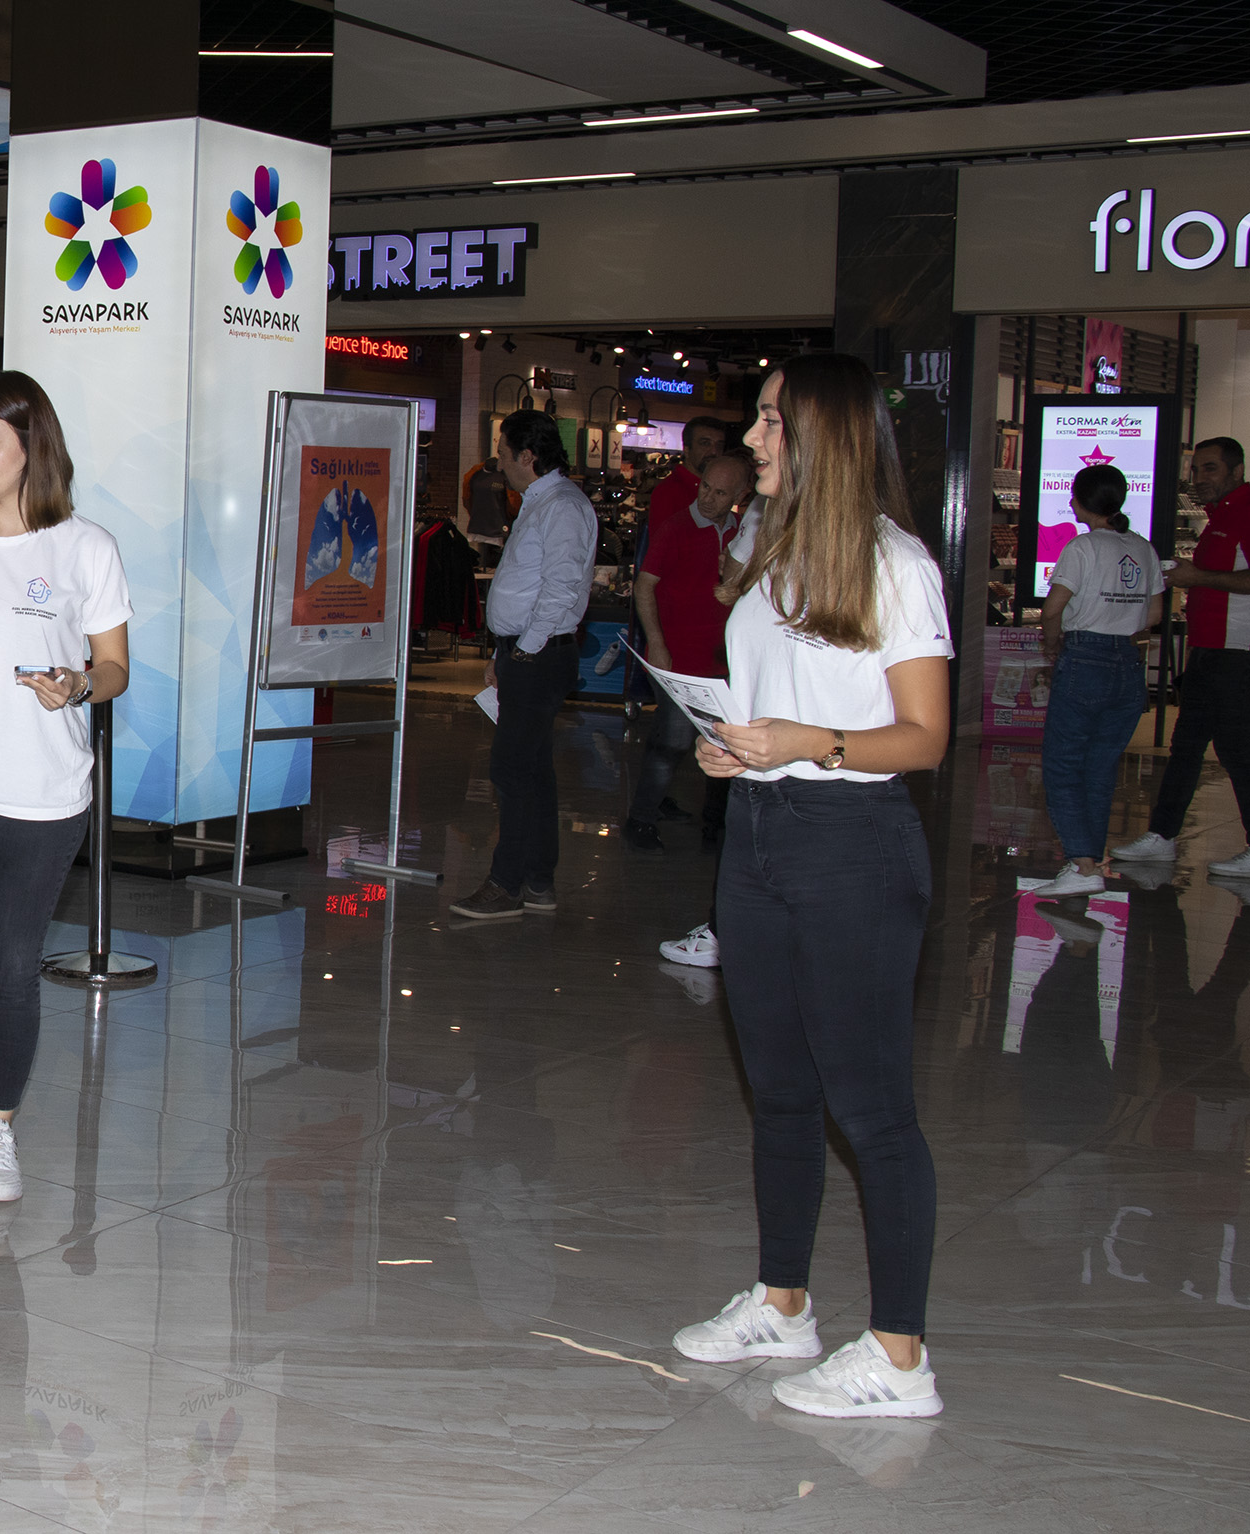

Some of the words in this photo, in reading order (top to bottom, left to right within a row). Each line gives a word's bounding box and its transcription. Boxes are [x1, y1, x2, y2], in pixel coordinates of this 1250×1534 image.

[42, 301, 149, 323] SAYAPARK
[223, 305, 300, 332] SAYAPARK
[49, 326, 78, 335] Alışveriş
[89, 326, 111, 335] Yaşam
[113, 325, 140, 333] Merkezi
[361, 336, 379, 356] the
[382, 341, 408, 359] shoe
[635, 376, 656, 390] street
[1056, 417, 1109, 425] FLORMAR
[311, 458, 363, 479] Sağlıklı
[1126, 480, 1151, 492] DİYE!
